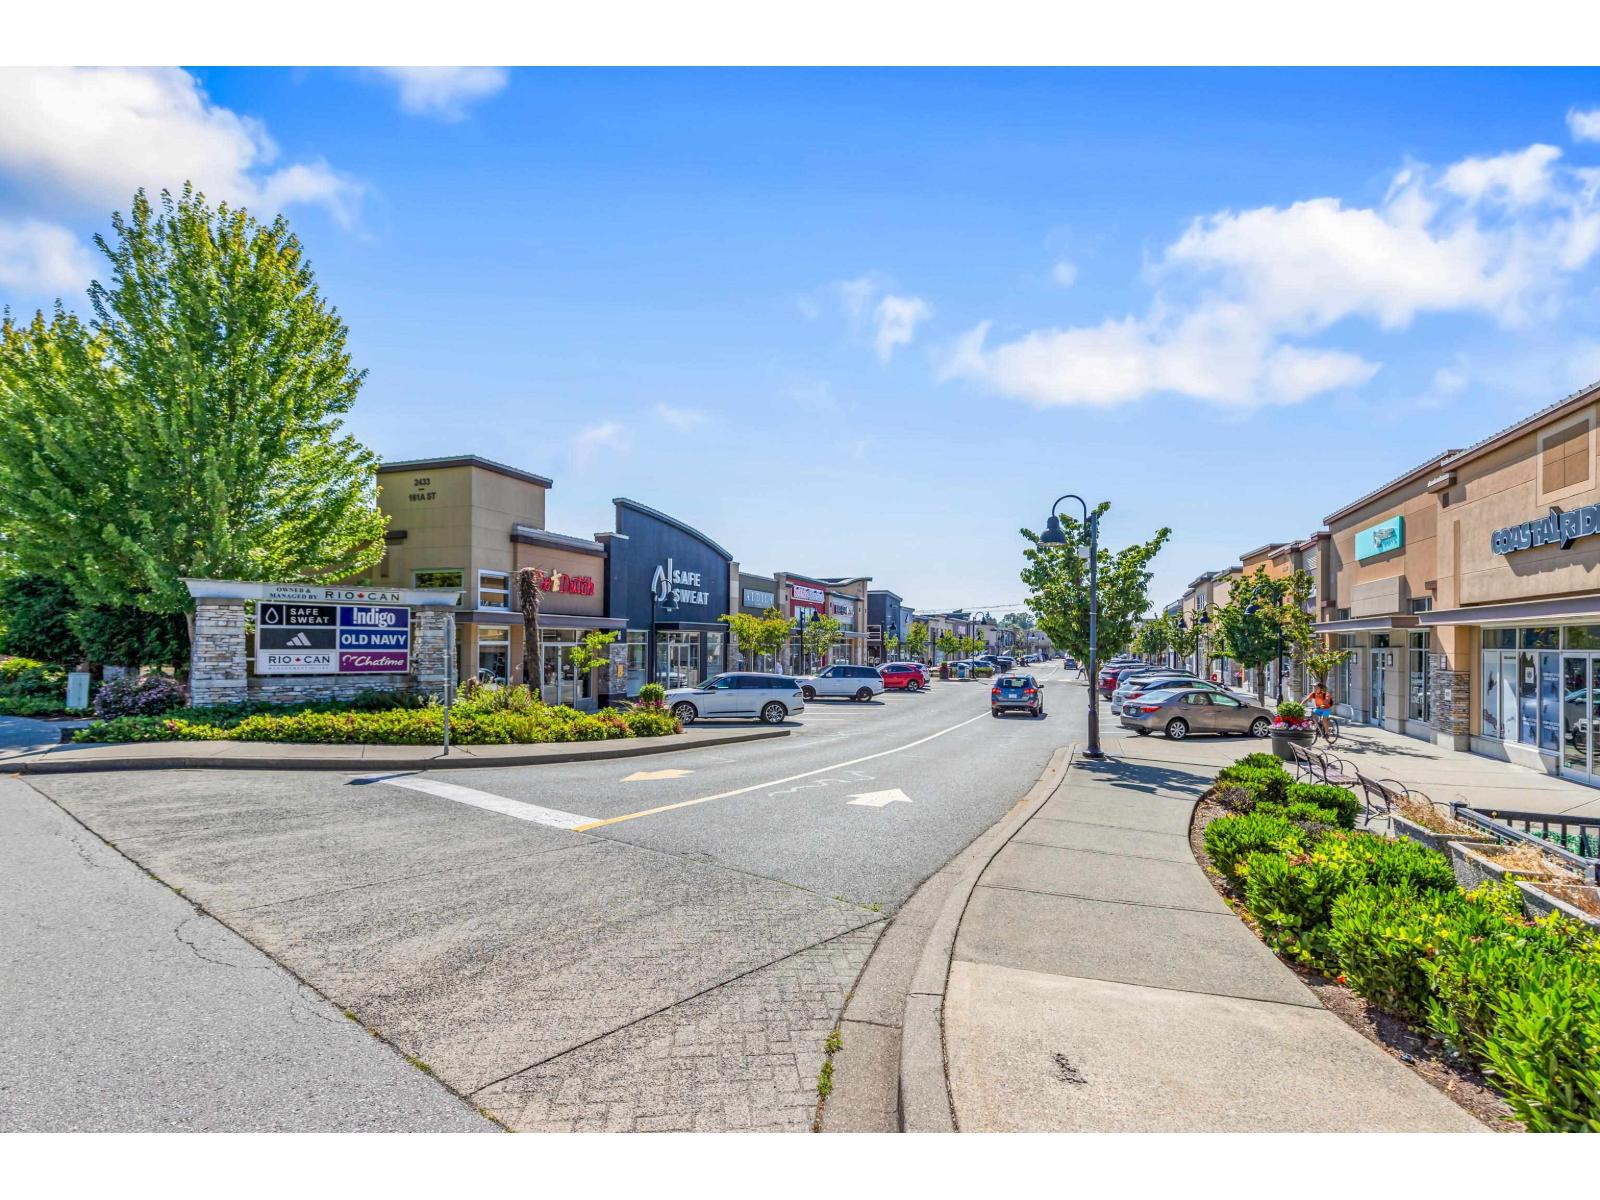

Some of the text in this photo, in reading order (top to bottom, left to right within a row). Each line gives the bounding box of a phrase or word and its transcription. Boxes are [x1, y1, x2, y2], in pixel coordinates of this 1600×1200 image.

[1491, 508, 1560, 555] COASTAL
[673, 569, 701, 587] SAFE
[325, 590, 400, 601] RIO CAN
[672, 588, 710, 606] SWEAT
[290, 607, 319, 616] SAFE
[290, 616, 329, 624] SWEAT
[341, 634, 407, 645] OLD NAVY
[268, 655, 330, 664] RIO CAN
[354, 654, 404, 667] Chatime
